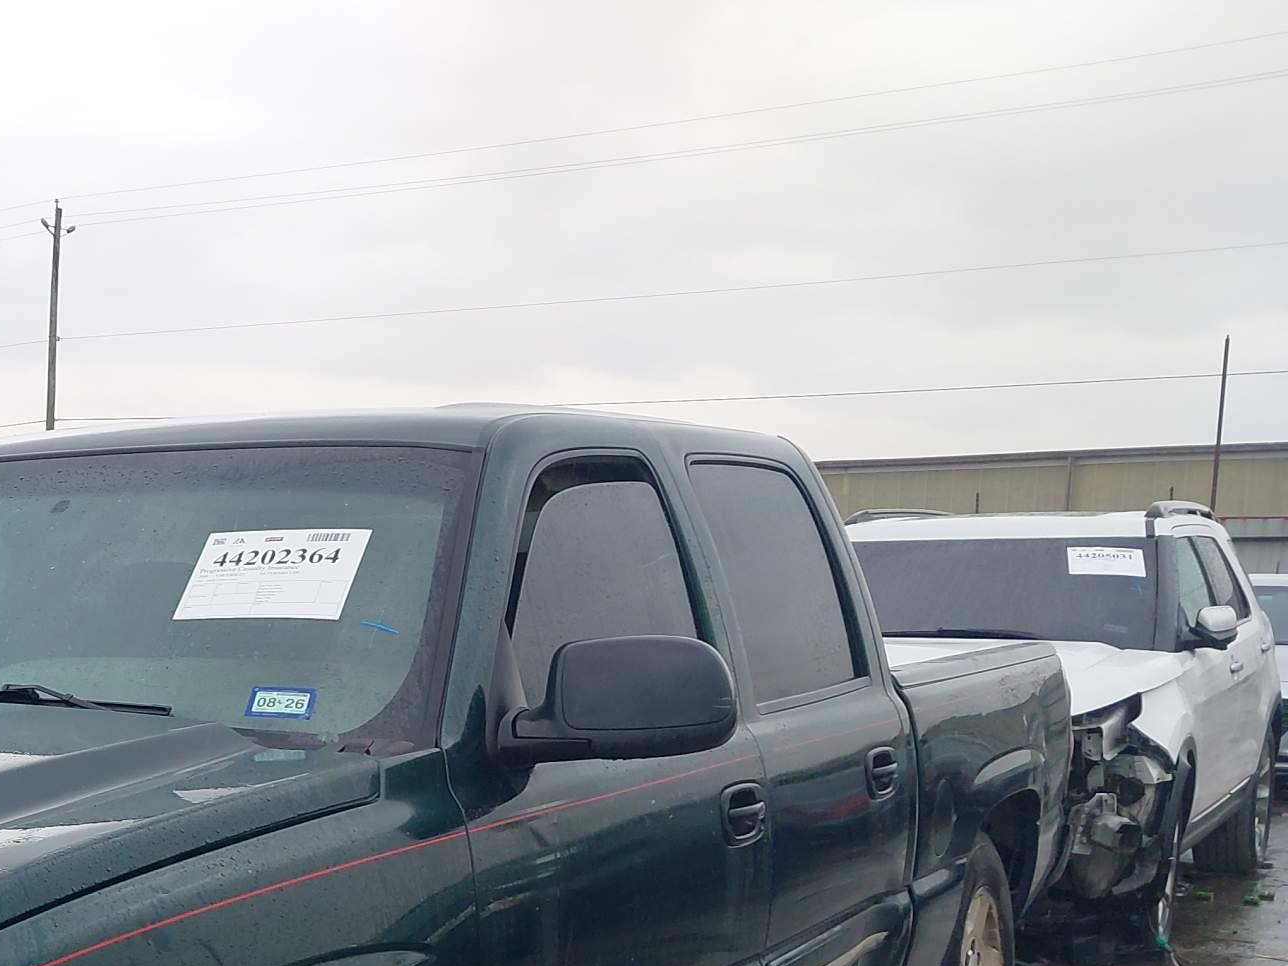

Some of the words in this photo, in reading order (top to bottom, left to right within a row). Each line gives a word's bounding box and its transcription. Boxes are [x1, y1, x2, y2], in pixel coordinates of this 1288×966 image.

[213, 548, 341, 567] 44202364
[256, 697, 277, 708] 08
[284, 698, 306, 709] 26
